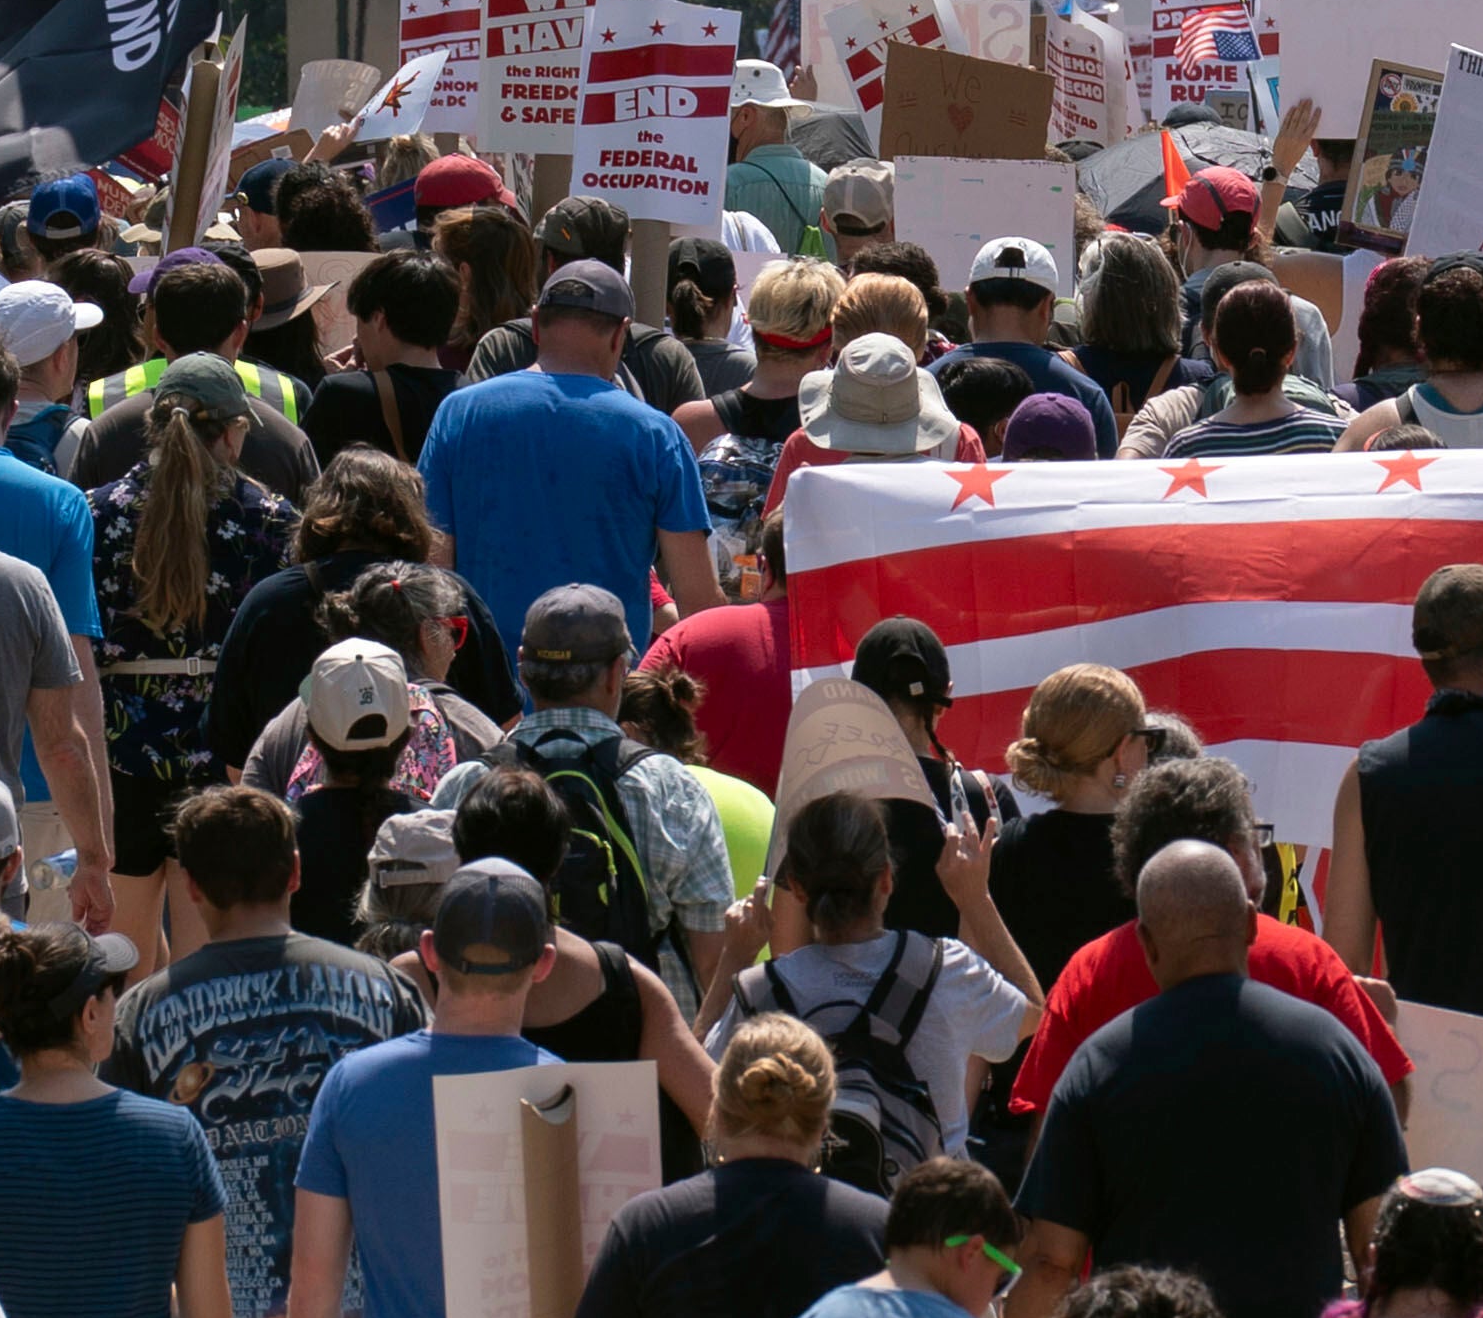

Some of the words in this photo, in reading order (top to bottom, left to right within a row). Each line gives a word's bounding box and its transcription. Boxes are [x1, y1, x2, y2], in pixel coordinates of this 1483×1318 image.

[506, 64, 532, 77] the
[535, 65, 580, 79] RIGHT
[1165, 65, 1238, 82] HOME
[616, 87, 698, 121] END
[501, 106, 517, 122] &
[638, 130, 664, 143] the
[599, 150, 699, 174] FEDERAL
[582, 173, 709, 196] OCCUPATION
